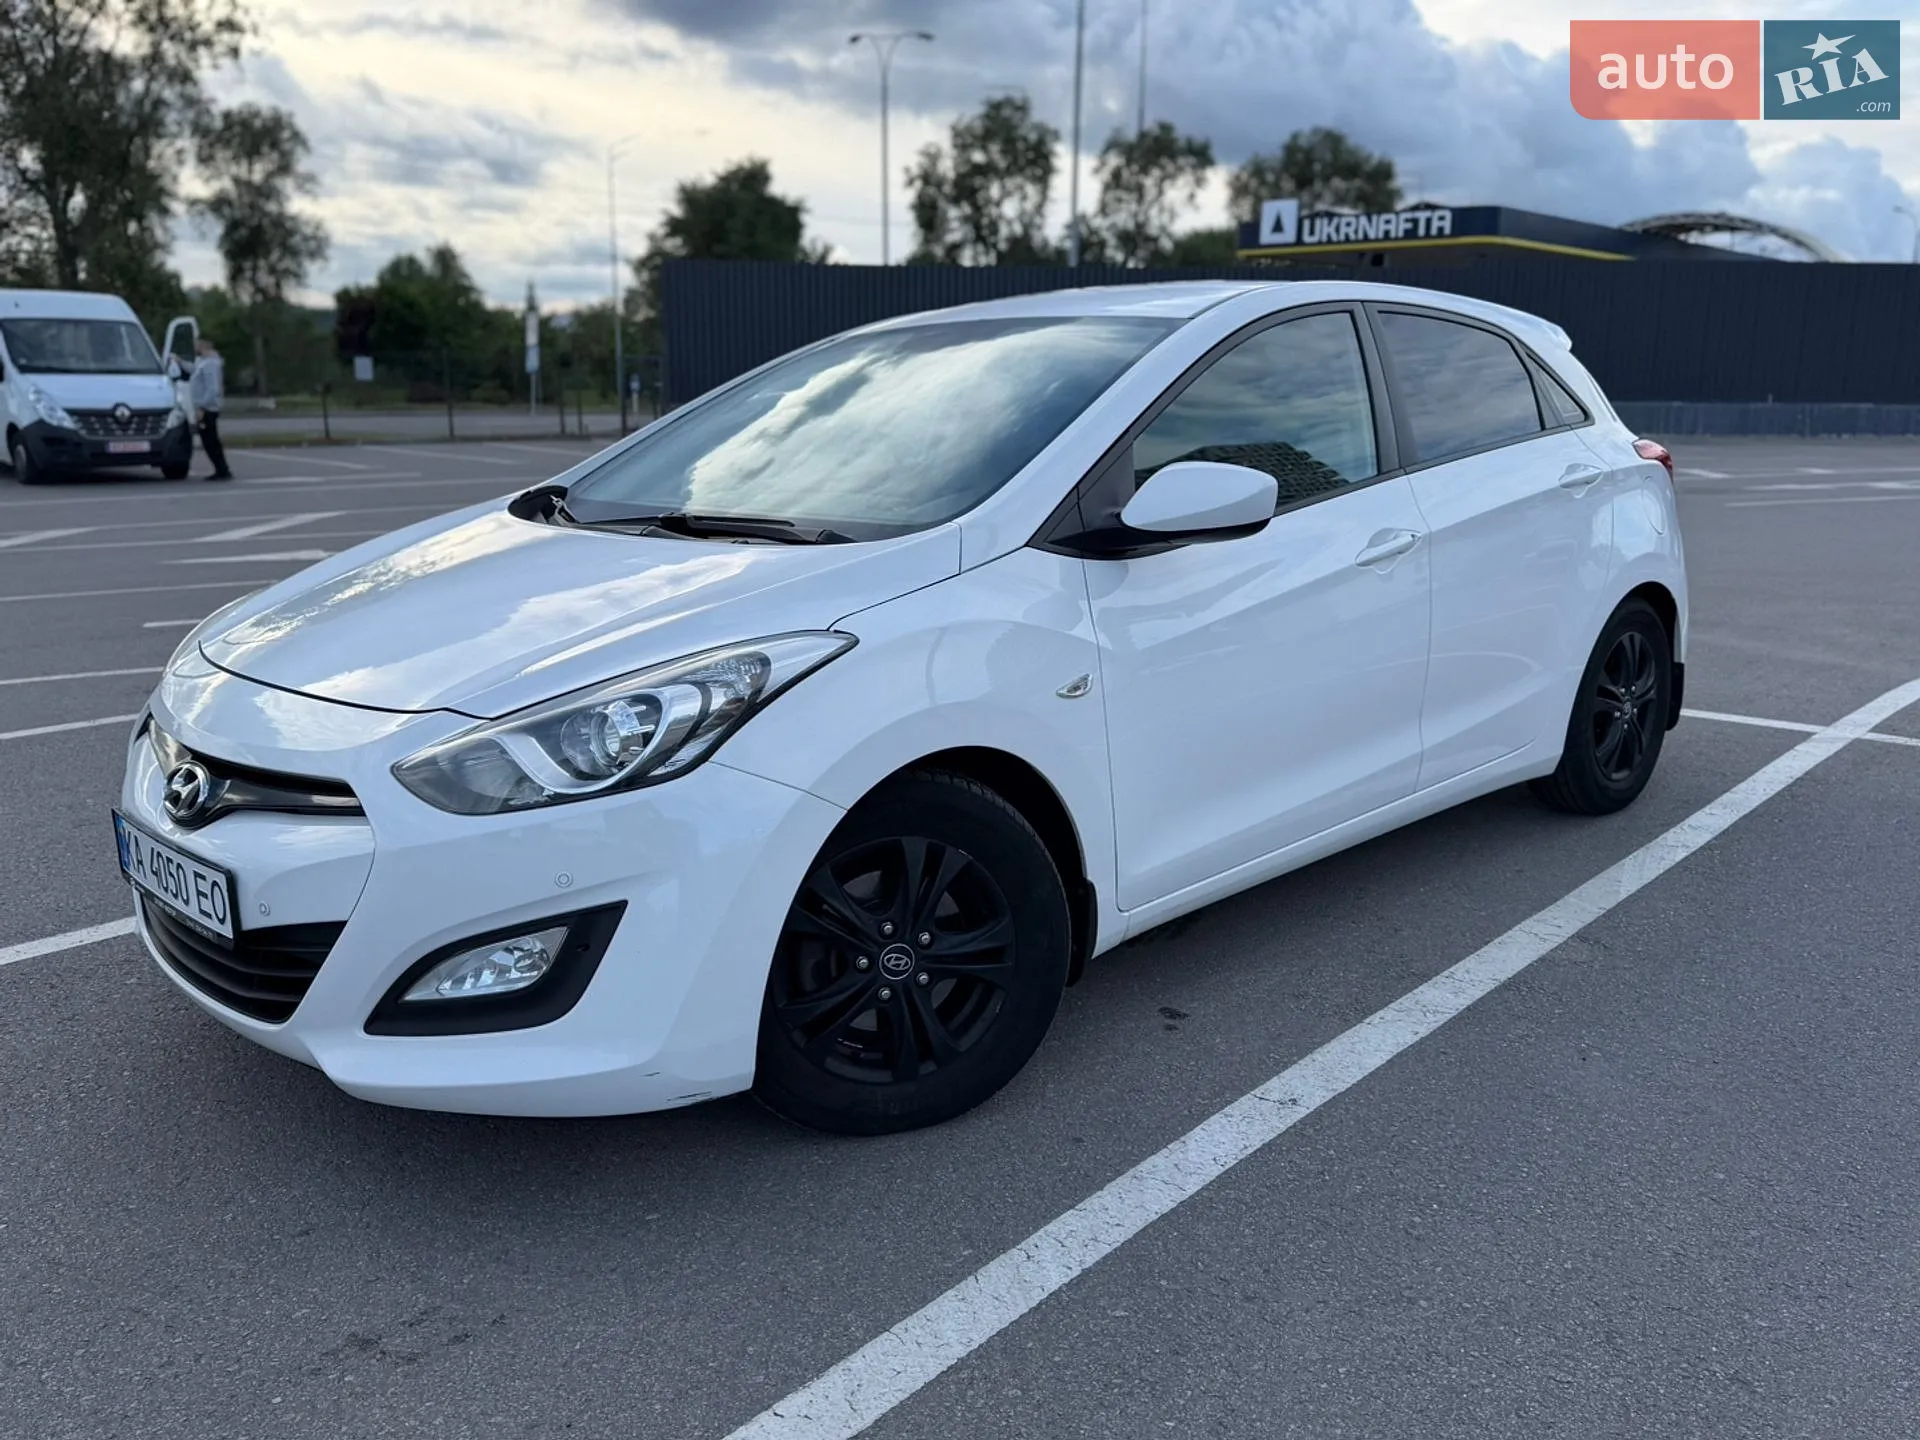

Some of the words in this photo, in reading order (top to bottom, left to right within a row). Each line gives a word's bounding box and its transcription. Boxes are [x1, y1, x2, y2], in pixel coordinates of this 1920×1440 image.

[1301, 209, 1453, 244] UKRNAFTA
[150, 846, 190, 907] 4050
[193, 869, 227, 926] EO
